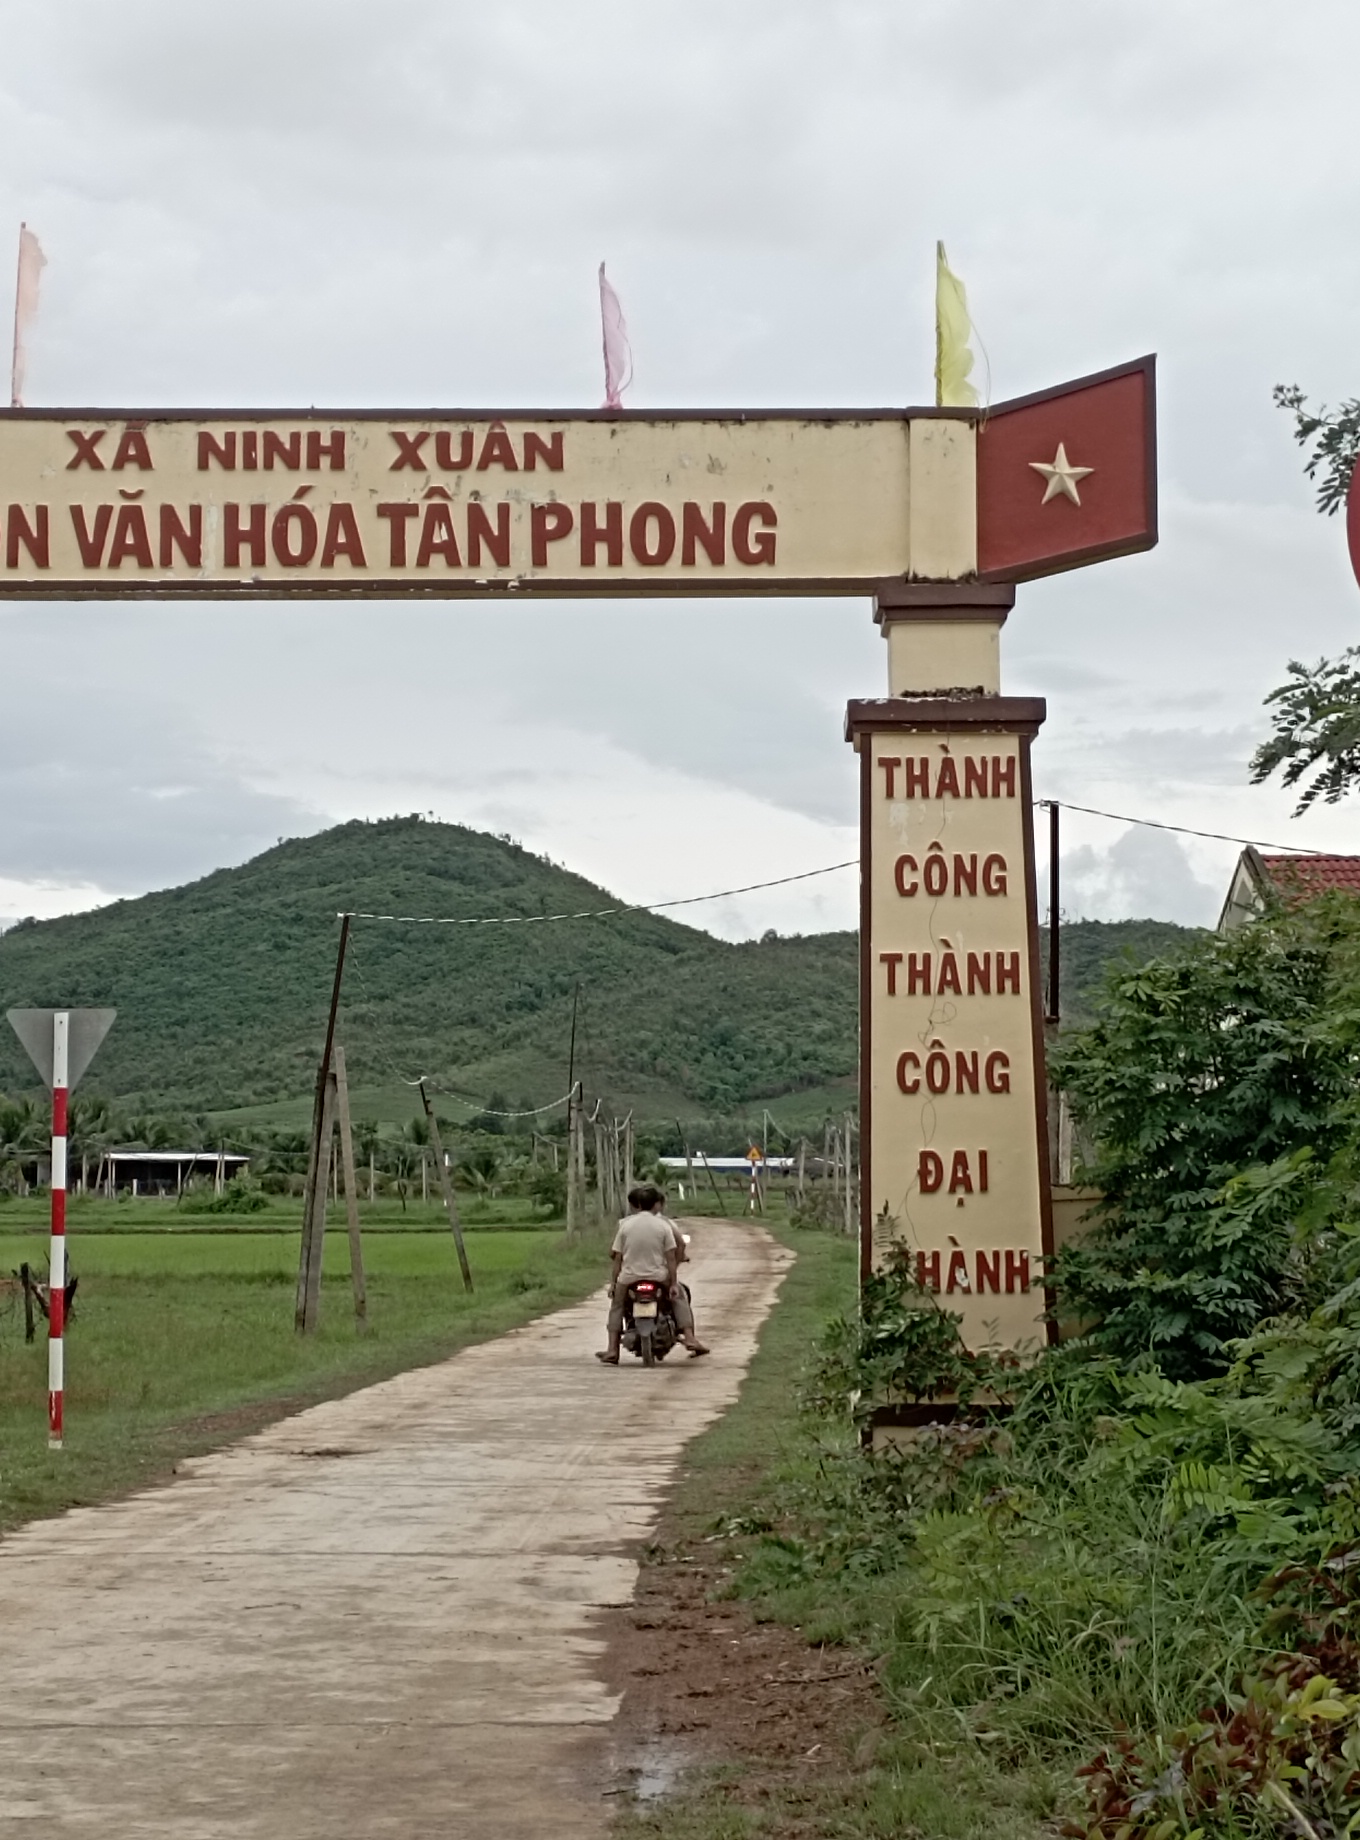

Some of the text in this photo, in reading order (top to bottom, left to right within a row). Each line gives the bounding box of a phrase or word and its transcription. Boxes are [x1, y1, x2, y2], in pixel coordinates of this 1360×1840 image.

[197, 430, 346, 471] NINH
[389, 420, 564, 472] XUÂN
[69, 488, 203, 569] VĂN
[223, 485, 368, 568] HÓA
[377, 485, 512, 568] TÂN
[530, 500, 778, 568] PHONG
[877, 743, 1017, 800] THÀNH
[893, 840, 1009, 898] CÔNG
[879, 937, 1021, 996] THÀNH
[895, 1038, 1011, 1095] CÔNG
[917, 1149, 989, 1208] ĐẠI
